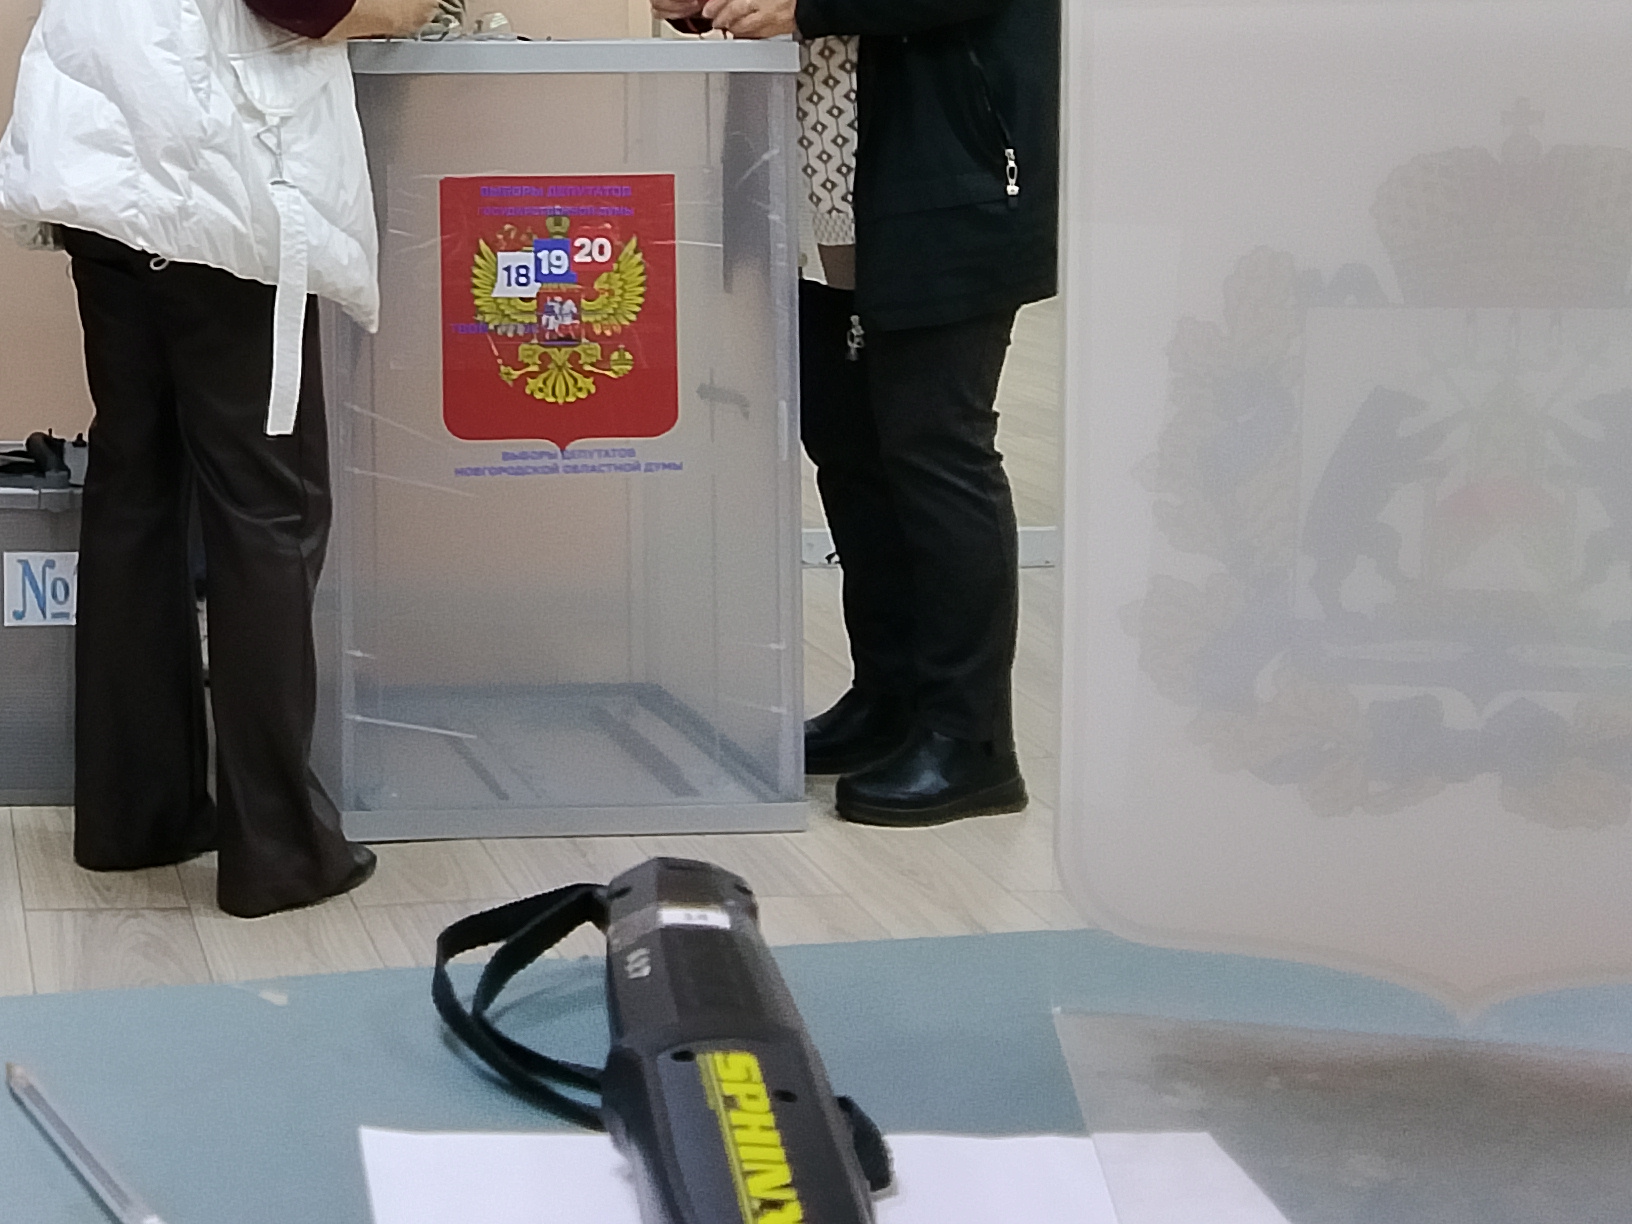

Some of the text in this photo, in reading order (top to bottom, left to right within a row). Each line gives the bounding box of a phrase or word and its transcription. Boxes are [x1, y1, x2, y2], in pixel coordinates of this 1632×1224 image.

[502, 237, 612, 287] 18 19 20
